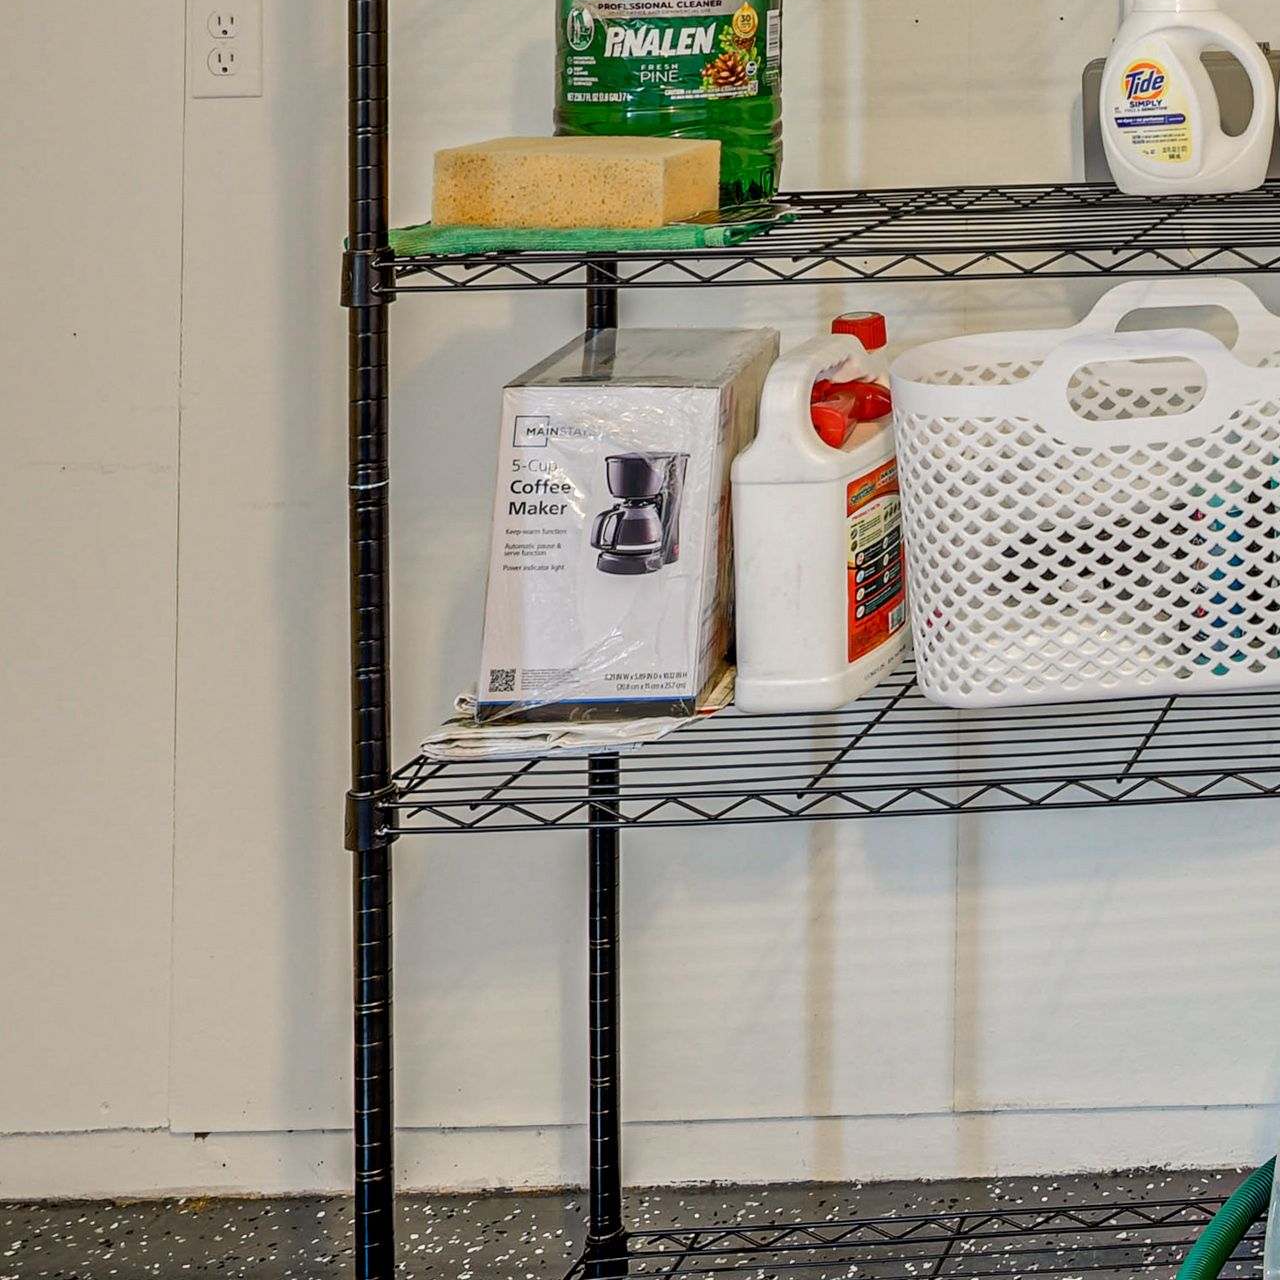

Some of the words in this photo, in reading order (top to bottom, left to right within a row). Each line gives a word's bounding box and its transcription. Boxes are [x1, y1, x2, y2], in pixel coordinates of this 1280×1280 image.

[640, 70, 679, 83] PINE
[1125, 70, 1165, 100] Tide
[1129, 100, 1162, 108] SIMPLY
[512, 459, 558, 475] 5-Cup
[510, 479, 572, 494] Coffee
[509, 501, 568, 515] Maker
